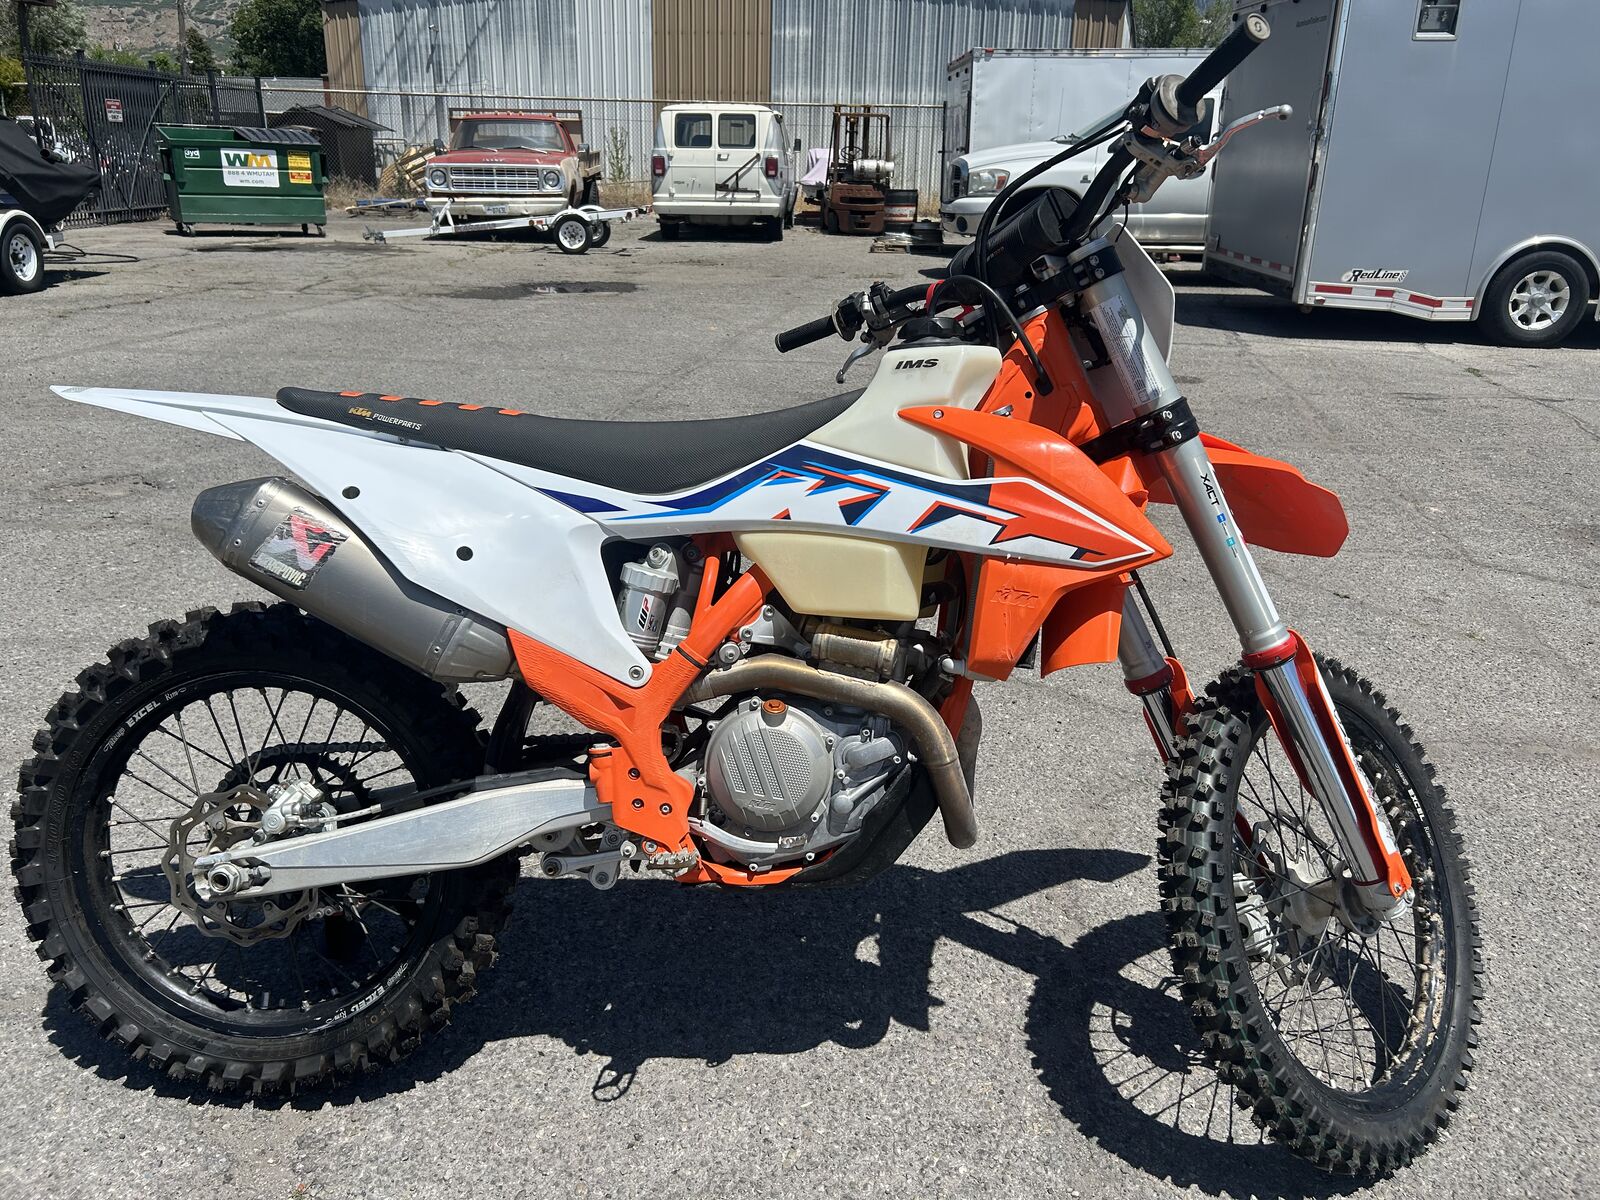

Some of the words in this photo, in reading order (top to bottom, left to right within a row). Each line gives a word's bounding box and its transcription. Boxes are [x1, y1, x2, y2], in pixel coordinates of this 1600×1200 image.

[224, 153, 272, 168] WM
[1347, 268, 1401, 282] RedLine
[895, 358, 939, 370] IMS
[348, 406, 373, 418] KTM
[372, 412, 422, 431] POWERPARTS
[1200, 472, 1221, 506] XACT
[125, 700, 161, 728] EXCEL
[1407, 788, 1425, 822] EXCEL
[350, 985, 386, 1012] EXCEL
